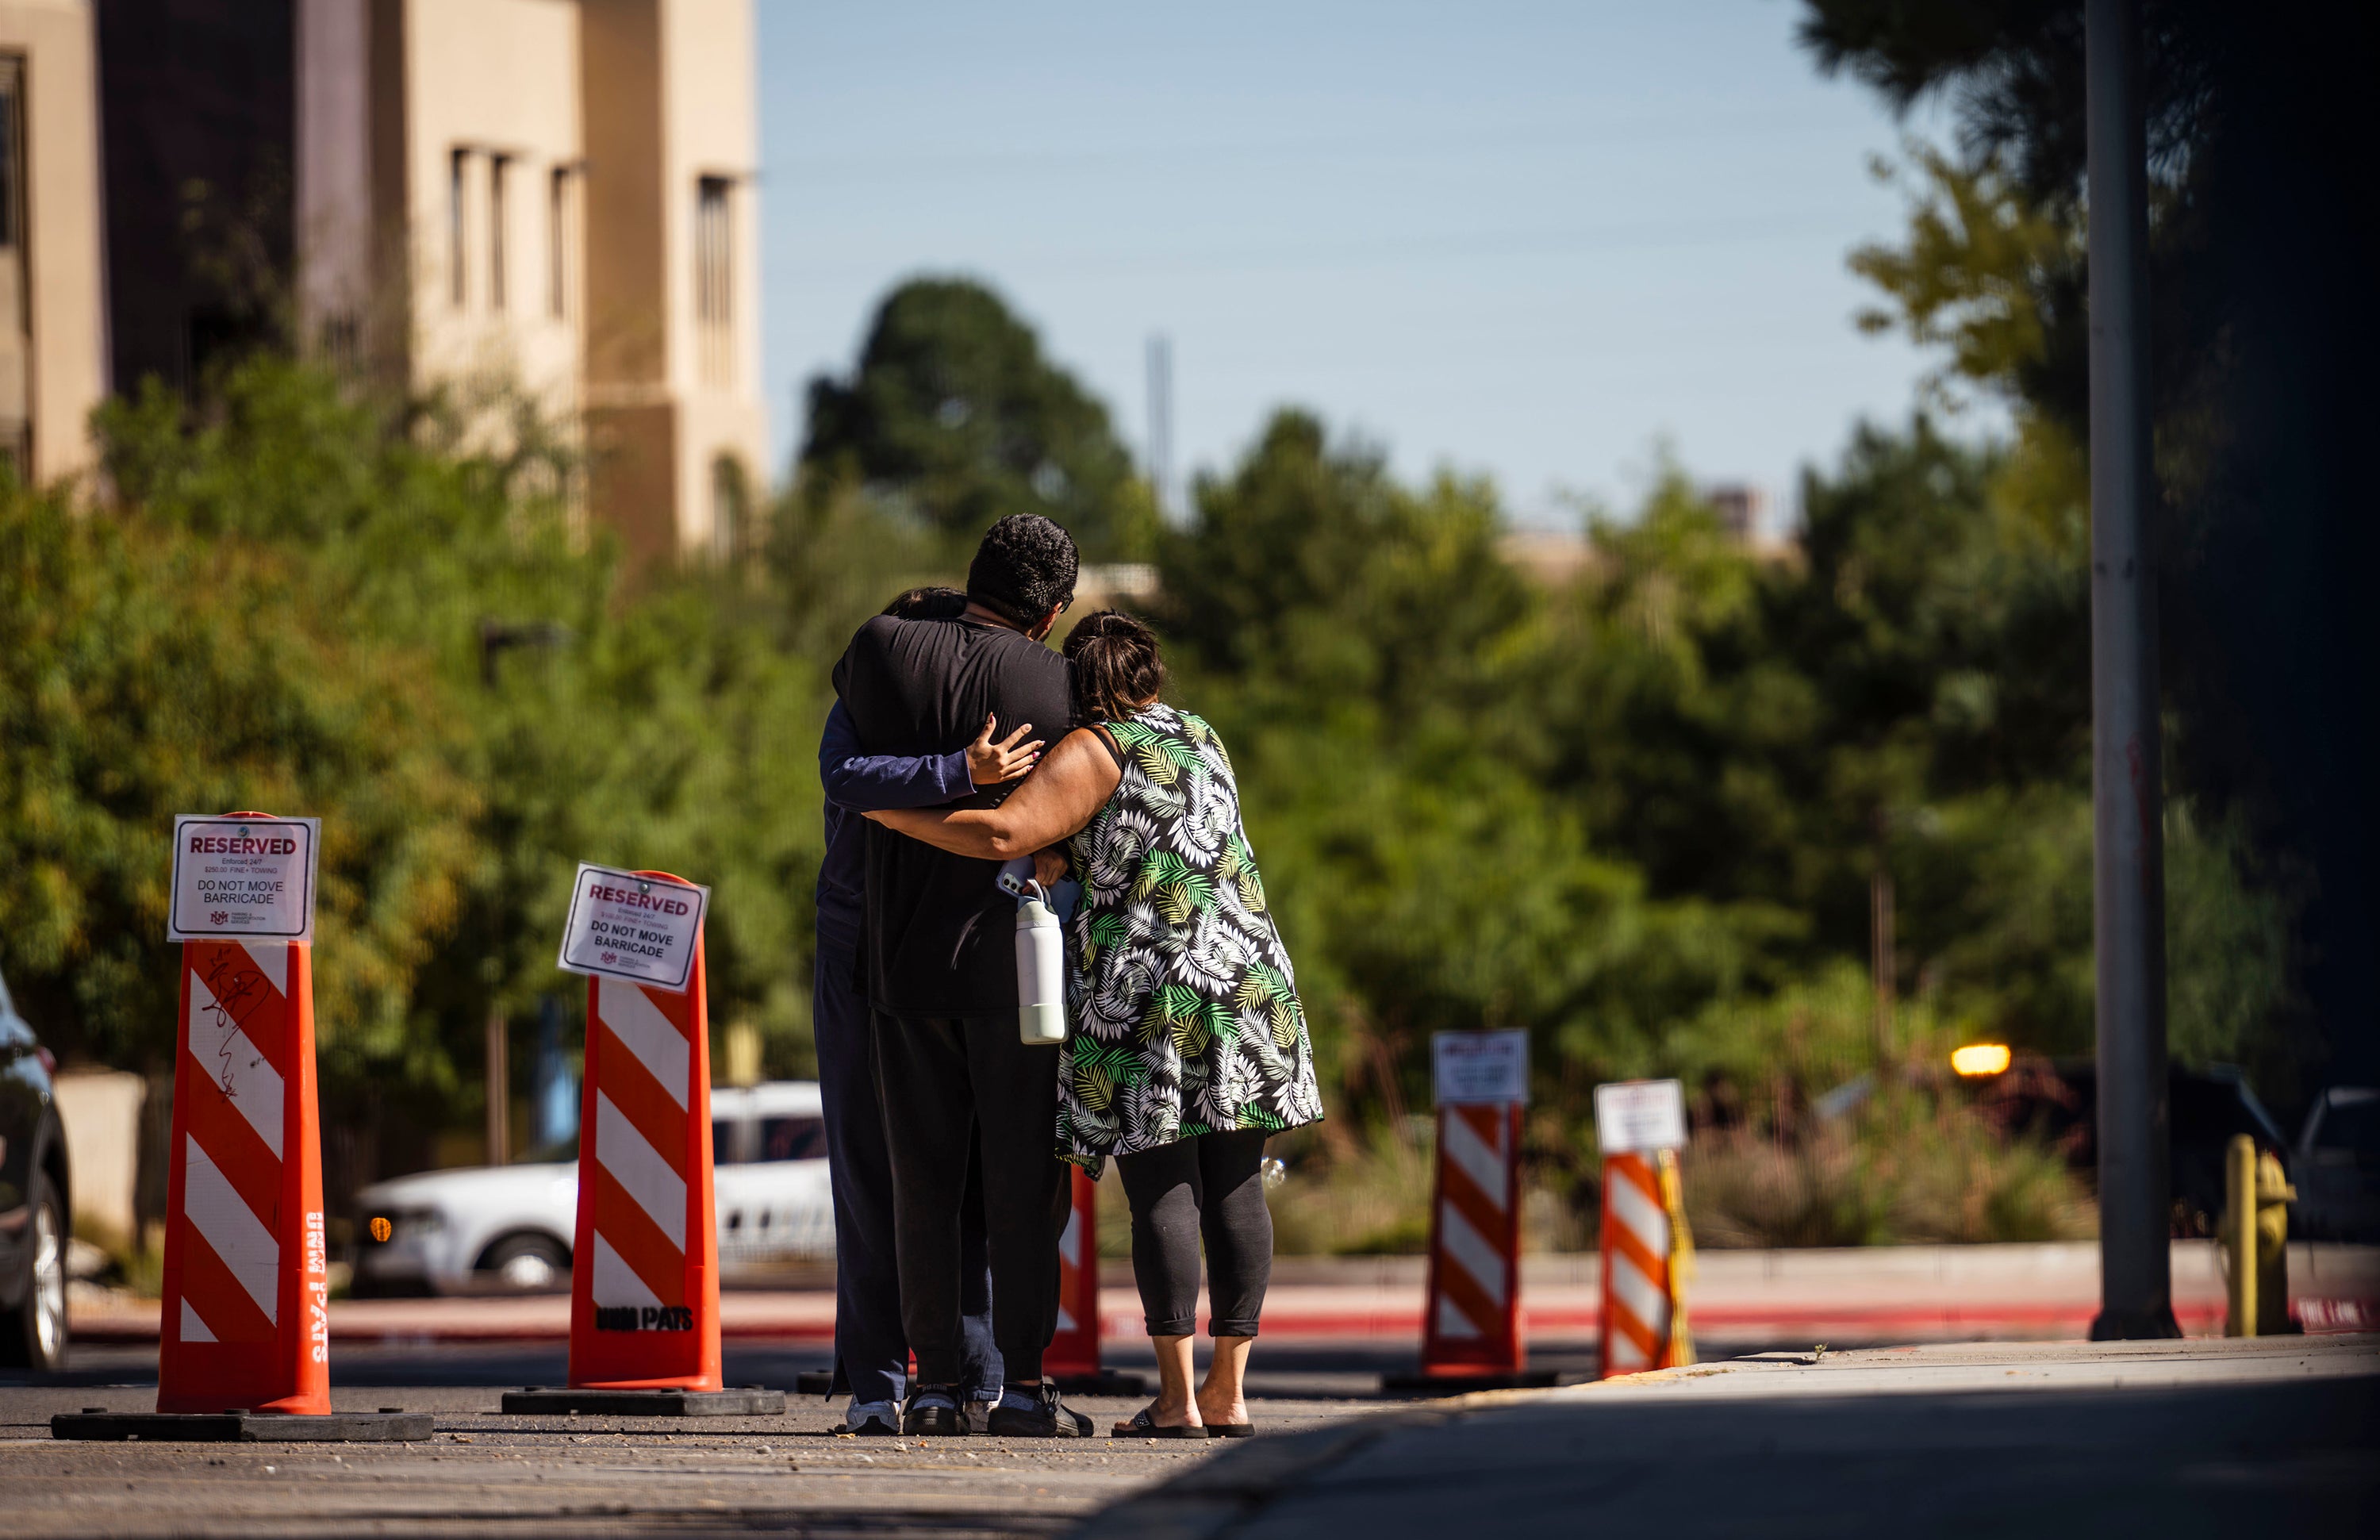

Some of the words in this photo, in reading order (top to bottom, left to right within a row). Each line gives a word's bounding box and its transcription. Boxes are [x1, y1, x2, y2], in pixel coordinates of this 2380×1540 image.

[190, 837, 297, 854] RESERVED
[198, 880, 215, 890] DO
[218, 881, 244, 891] NOT
[248, 881, 283, 892] MOVE
[204, 893, 274, 904] BARRICADE
[589, 884, 688, 916] RESERVED
[591, 920, 608, 933] DO
[612, 924, 636, 938] NOT
[639, 929, 674, 946] MOVE
[594, 935, 664, 958] BARRICADE
[305, 1212, 325, 1274] UNM
[309, 1281, 328, 1363] PATS
[642, 1307, 693, 1331] PATS
